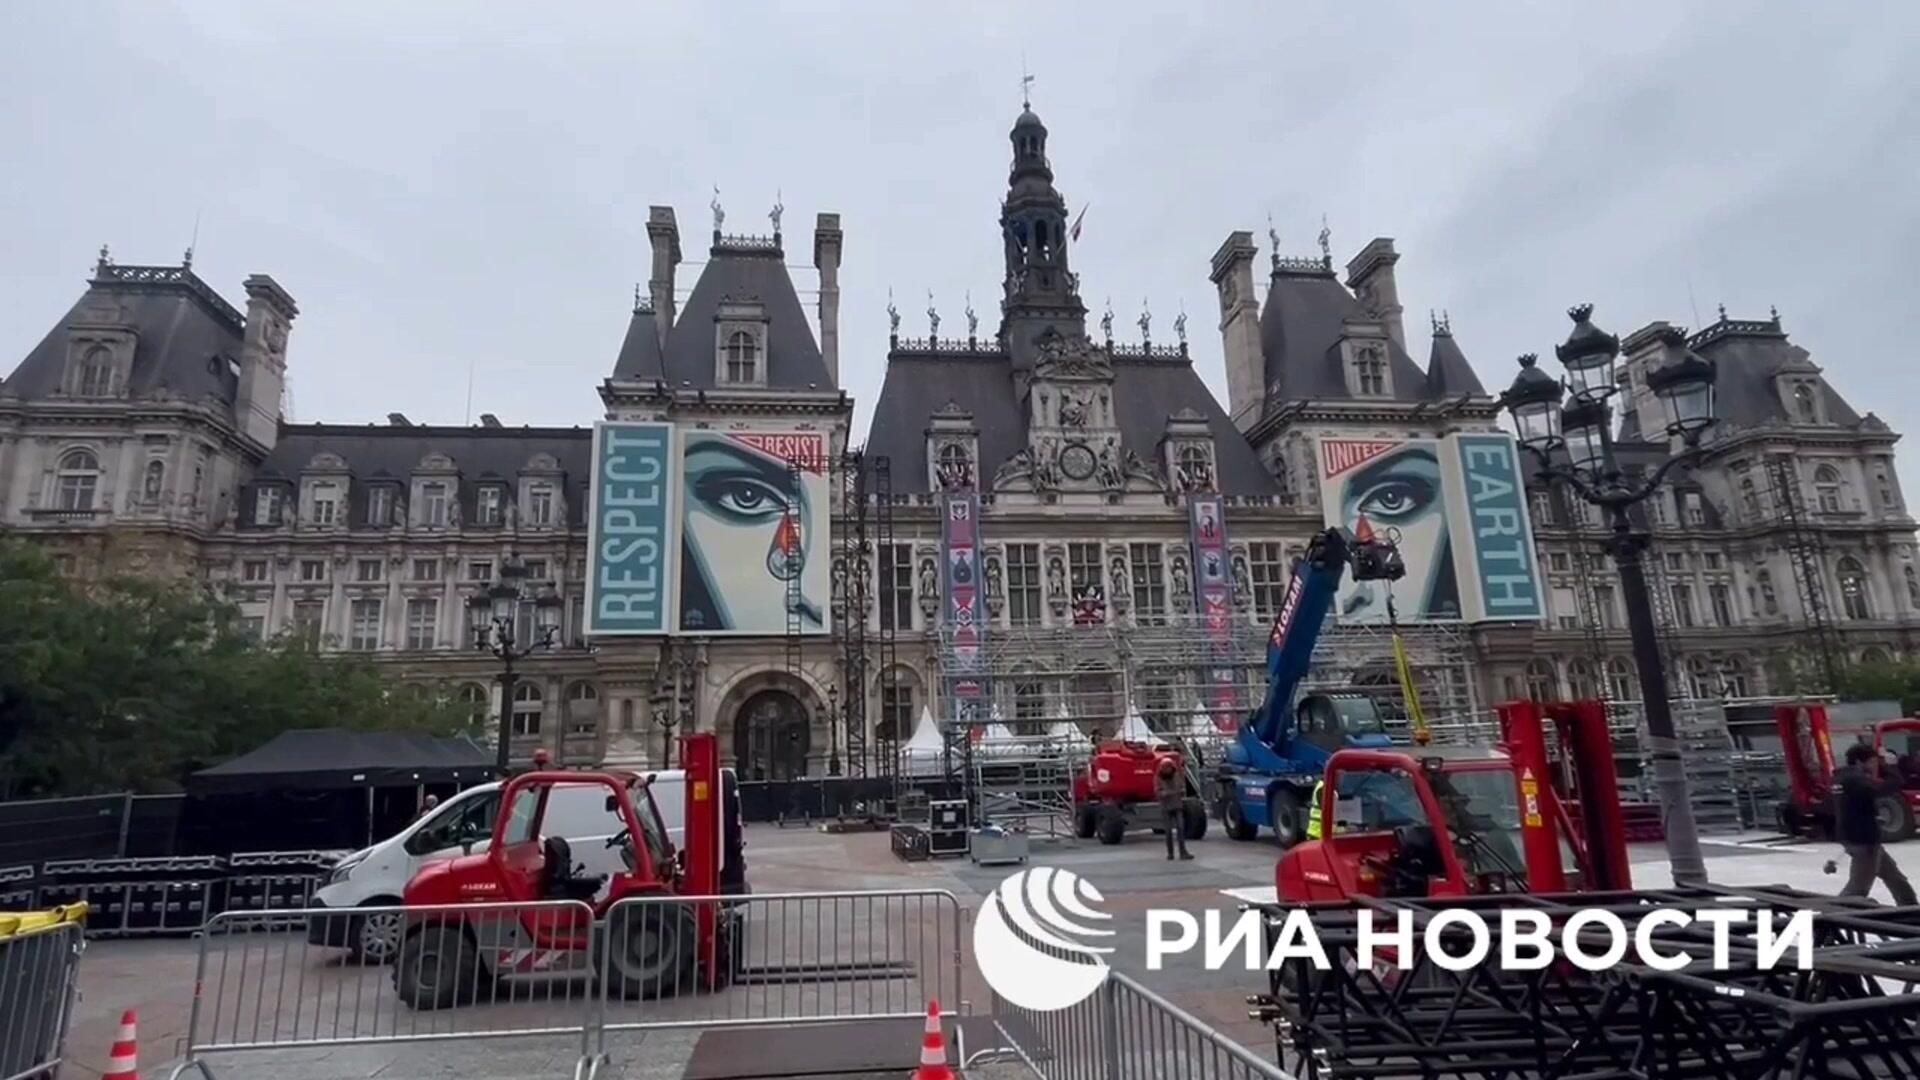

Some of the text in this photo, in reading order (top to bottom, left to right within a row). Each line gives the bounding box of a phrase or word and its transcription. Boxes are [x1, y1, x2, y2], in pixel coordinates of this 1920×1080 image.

[765, 436, 820, 468] RESIST
[599, 430, 661, 620] RESPECT
[1463, 444, 1534, 607] EARTH
[1278, 575, 1304, 635] LOXAM
